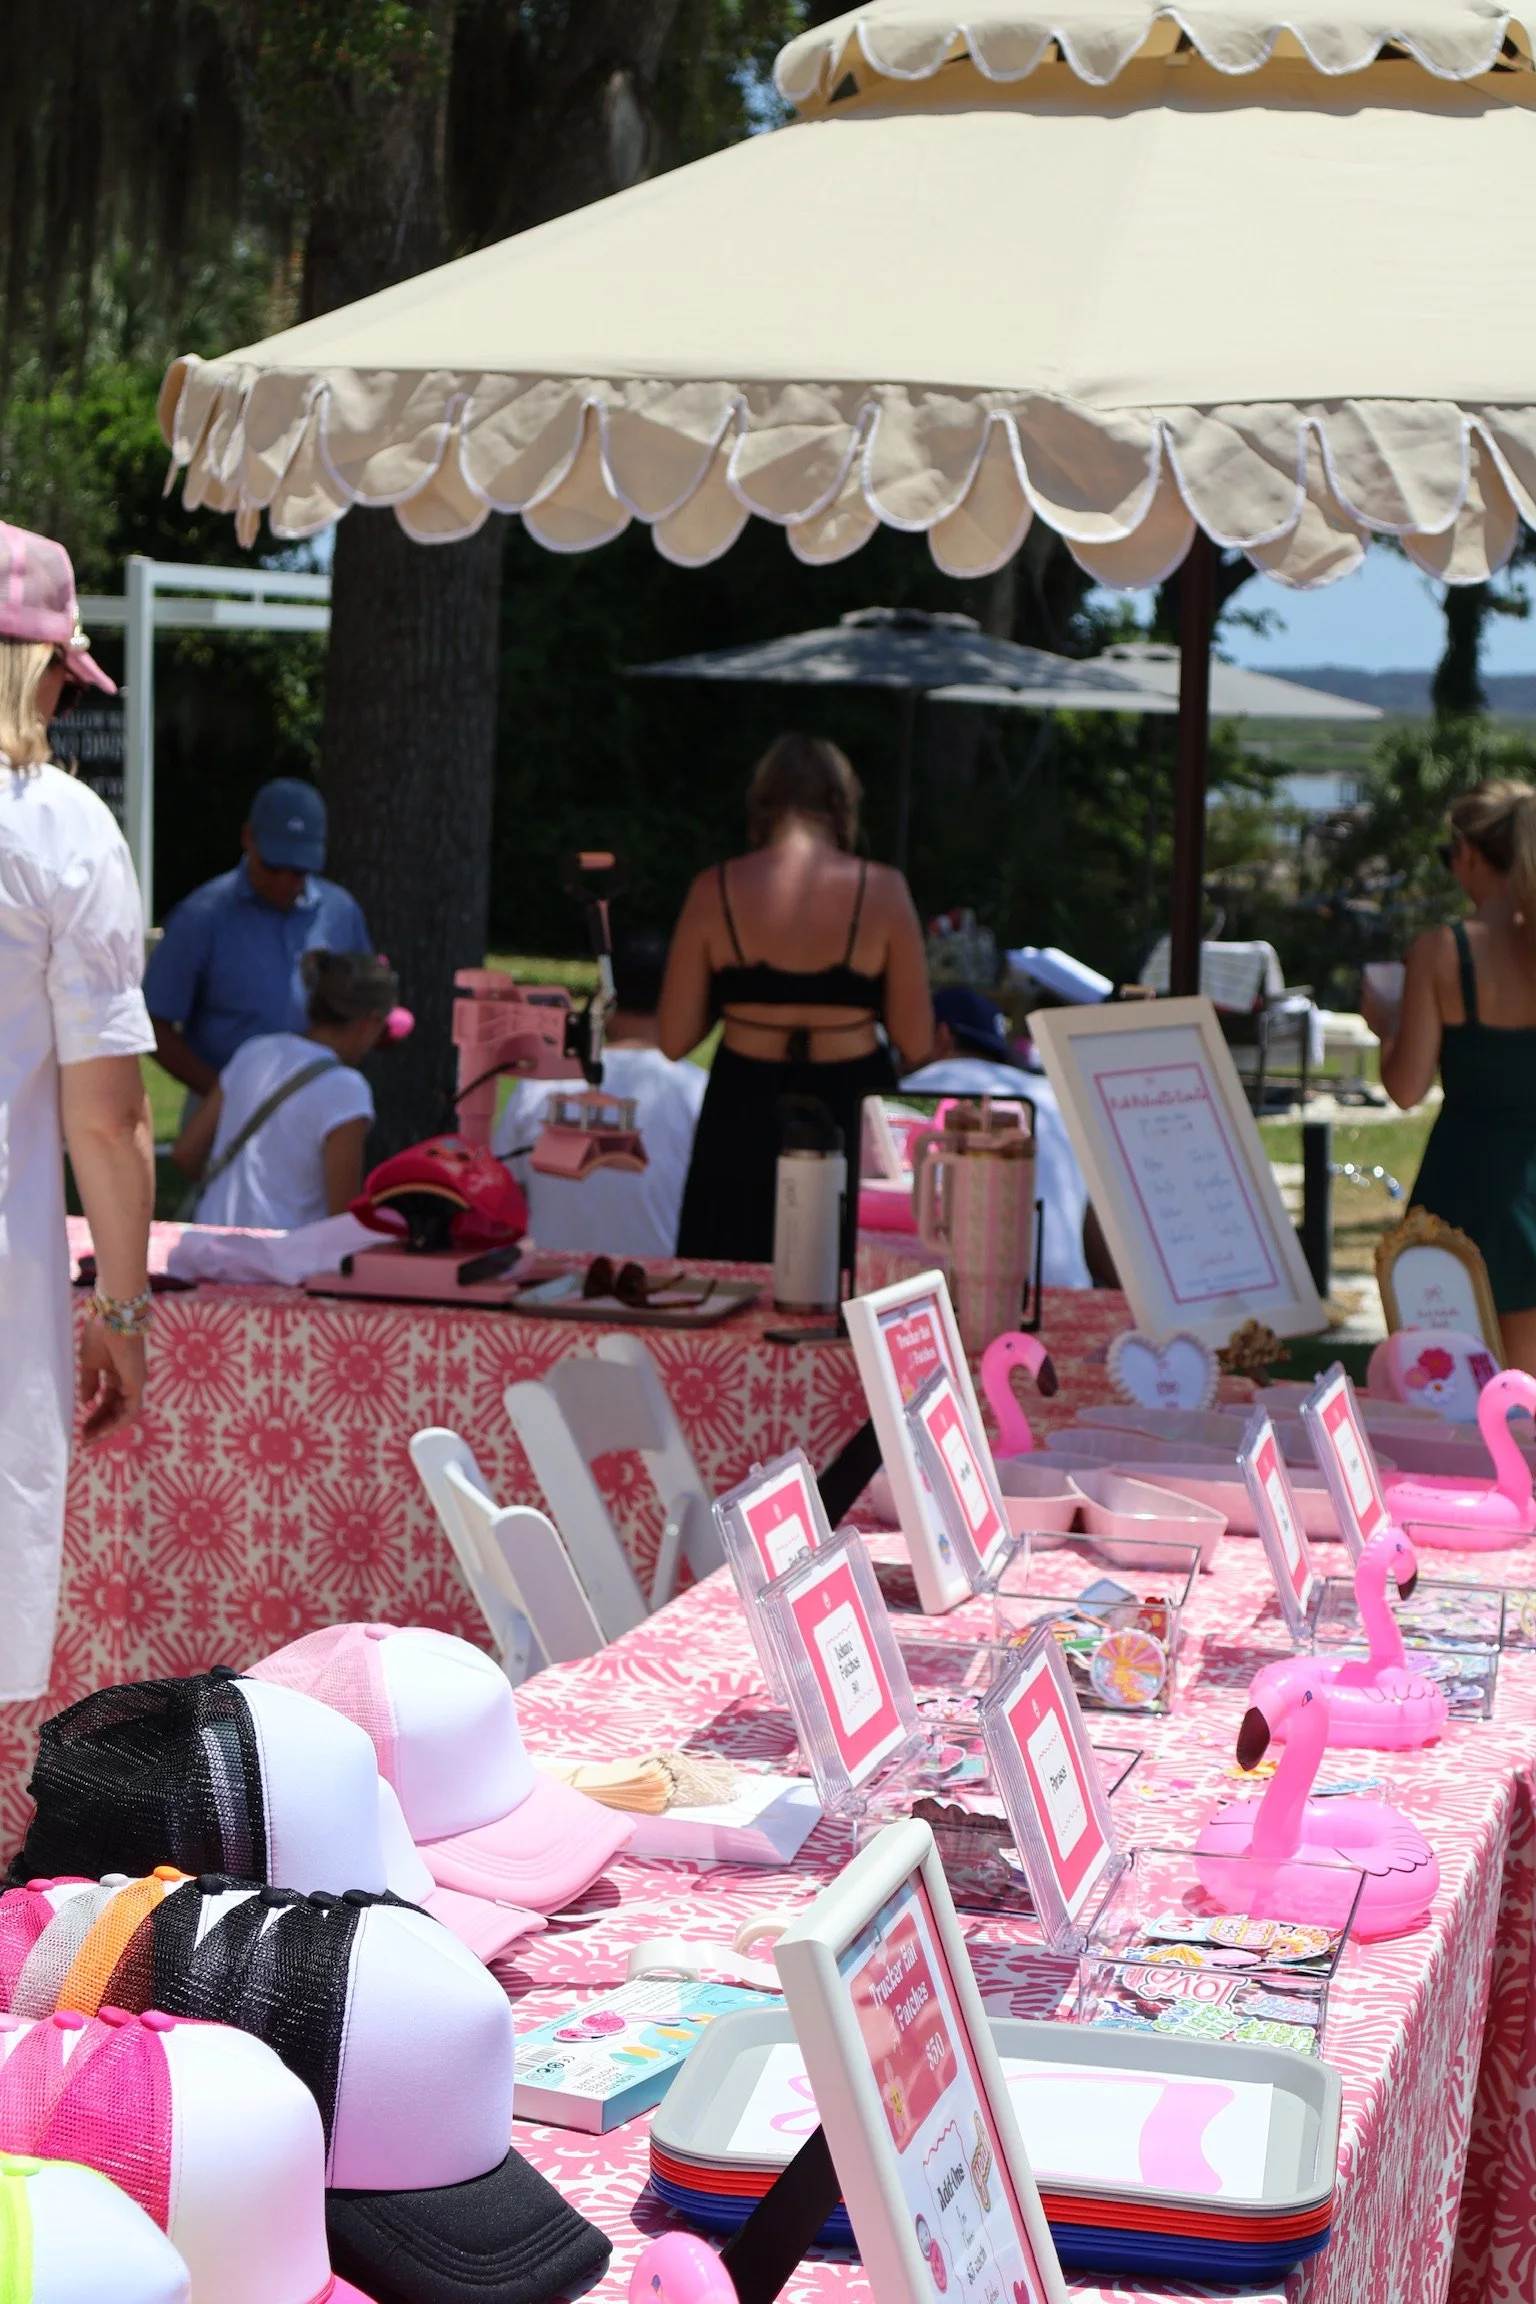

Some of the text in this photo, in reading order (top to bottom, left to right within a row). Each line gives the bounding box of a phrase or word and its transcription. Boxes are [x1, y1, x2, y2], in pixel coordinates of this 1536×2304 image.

[869, 1939, 919, 2010] Trucker Hat
[896, 1981, 930, 2032] Patches
[925, 2032, 945, 2072] $50
[938, 2161, 966, 2213] Add-Ons
